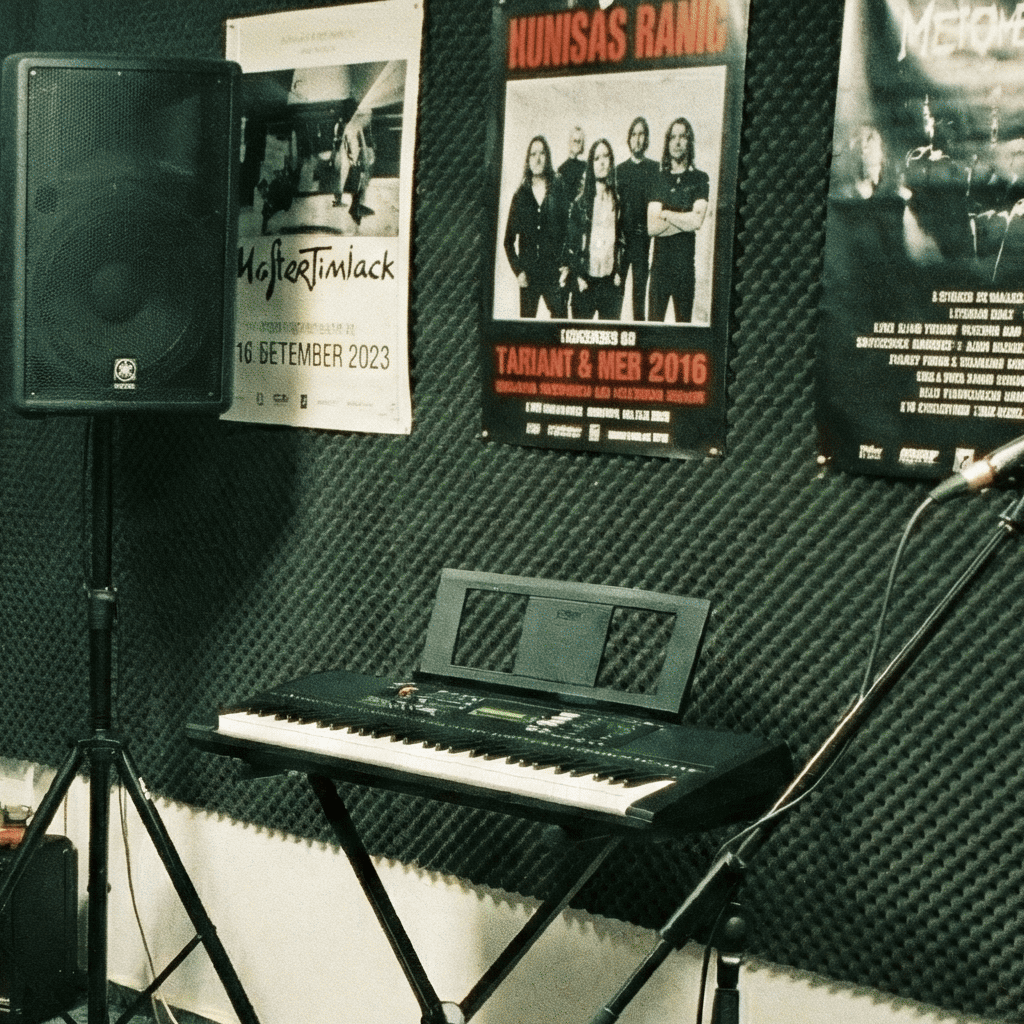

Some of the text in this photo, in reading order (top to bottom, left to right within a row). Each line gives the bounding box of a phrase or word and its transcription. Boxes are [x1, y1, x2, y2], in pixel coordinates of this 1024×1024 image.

[349, 344, 390, 370] 2023
[597, 350, 642, 381] MER
[648, 352, 707, 384] 2016
